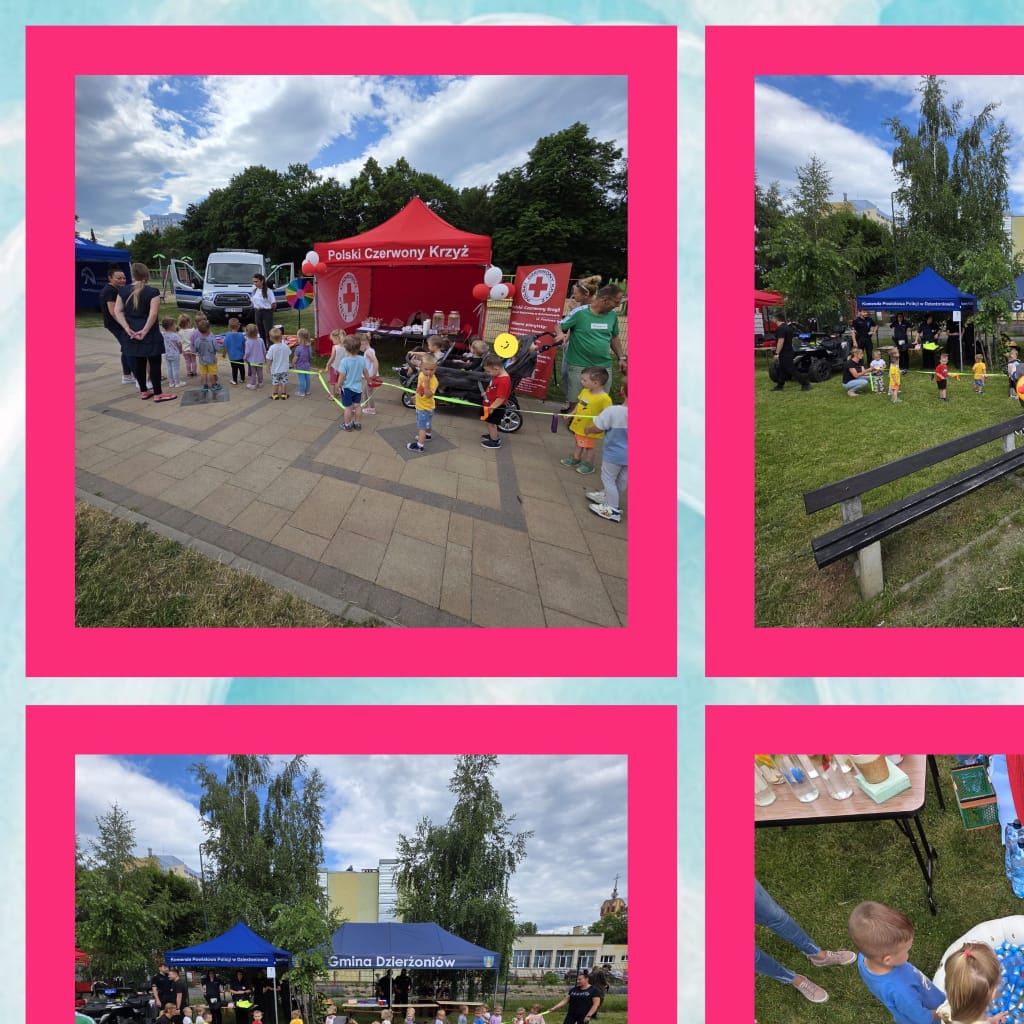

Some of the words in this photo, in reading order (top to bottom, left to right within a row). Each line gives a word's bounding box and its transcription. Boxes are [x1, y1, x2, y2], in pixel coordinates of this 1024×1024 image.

[328, 248, 361, 261] Polski
[364, 247, 426, 261] Czerwony
[429, 244, 469, 260] Krzyż
[328, 955, 372, 967] Gmina
[376, 955, 456, 968] Dzierżoniów
